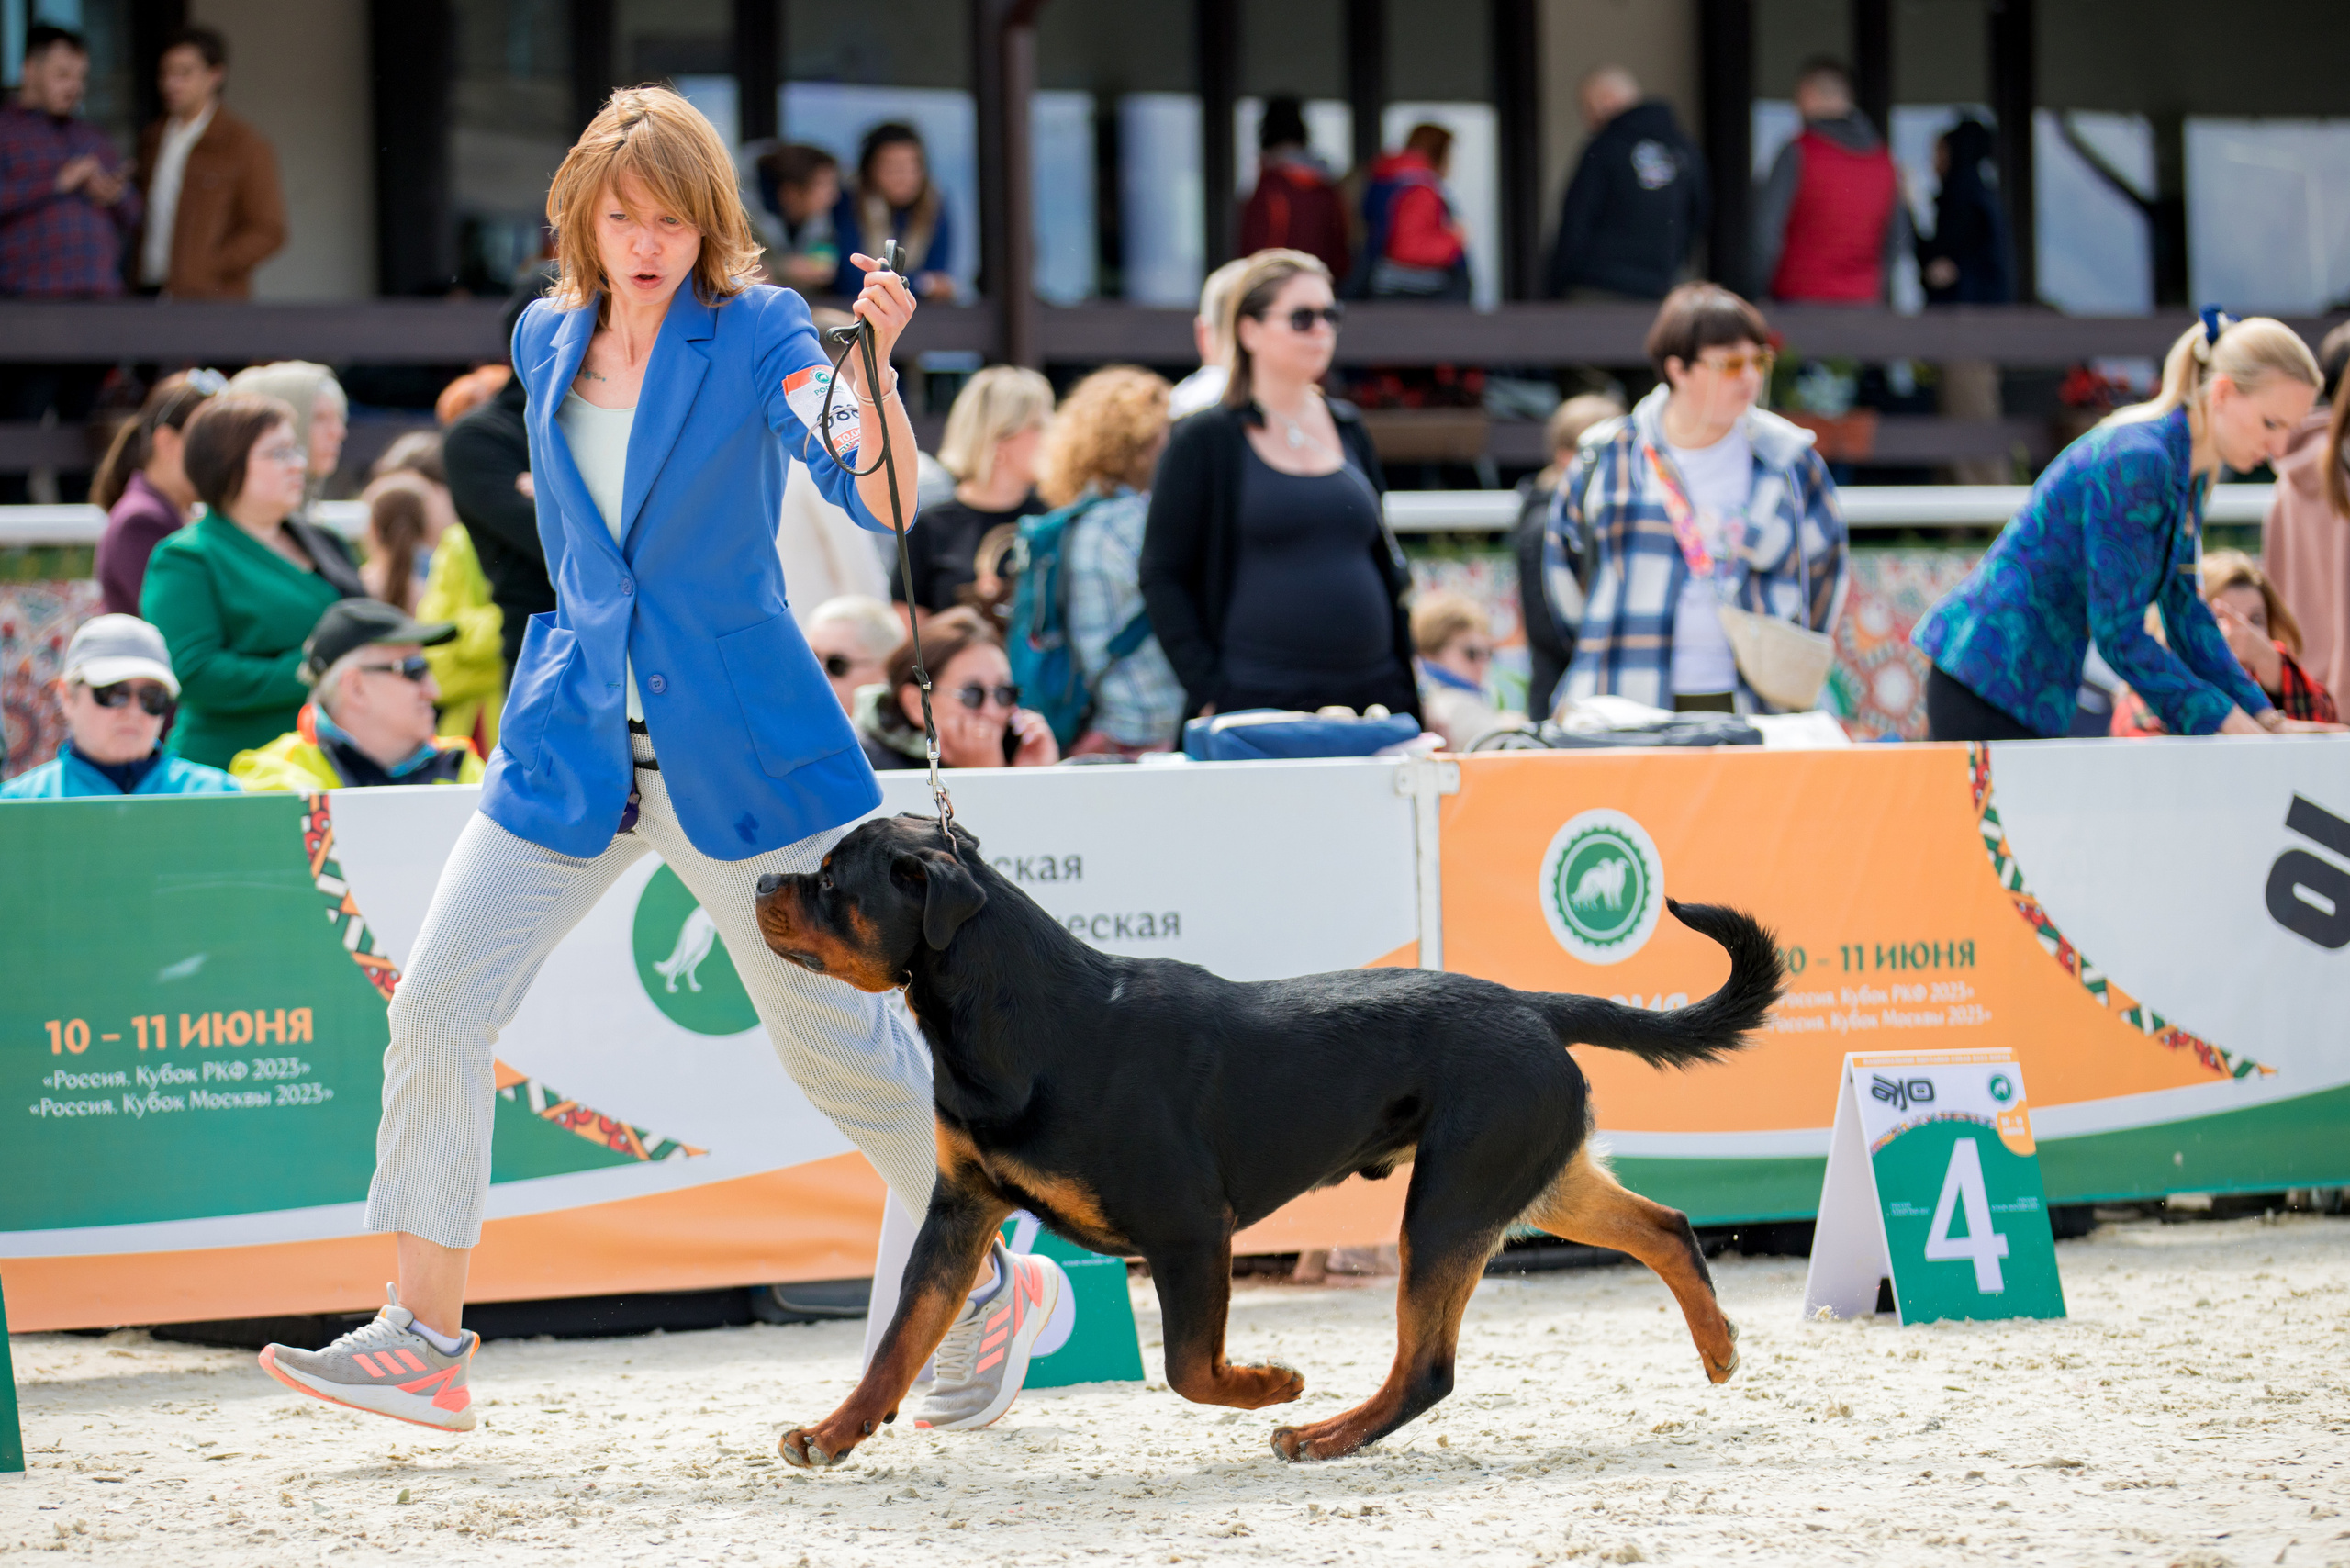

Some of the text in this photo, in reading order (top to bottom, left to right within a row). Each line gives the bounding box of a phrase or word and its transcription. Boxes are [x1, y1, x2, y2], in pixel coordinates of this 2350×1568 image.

[837, 429, 860, 444] 10.0
[1058, 911, 1181, 941] еская
[1779, 945, 1807, 974] 0
[1840, 943, 1865, 972] 11
[1876, 939, 1975, 969] ИЮНЯ
[1840, 984, 1889, 1009] Кубок
[45, 1017, 91, 1055] 10
[131, 1014, 167, 1050] 11
[179, 1007, 314, 1049] ИЮНЯ
[1830, 1010, 1879, 1035] Кубок
[1881, 1008, 1945, 1028] Москвы
[135, 1062, 198, 1091] Кубок
[202, 1059, 249, 1082] РКФ
[252, 1056, 312, 1081] 2023»
[122, 1091, 185, 1119] Кубок
[189, 1088, 272, 1111] Москвы
[274, 1081, 335, 1106] 2023»
[1924, 1137, 2009, 1294] 4
